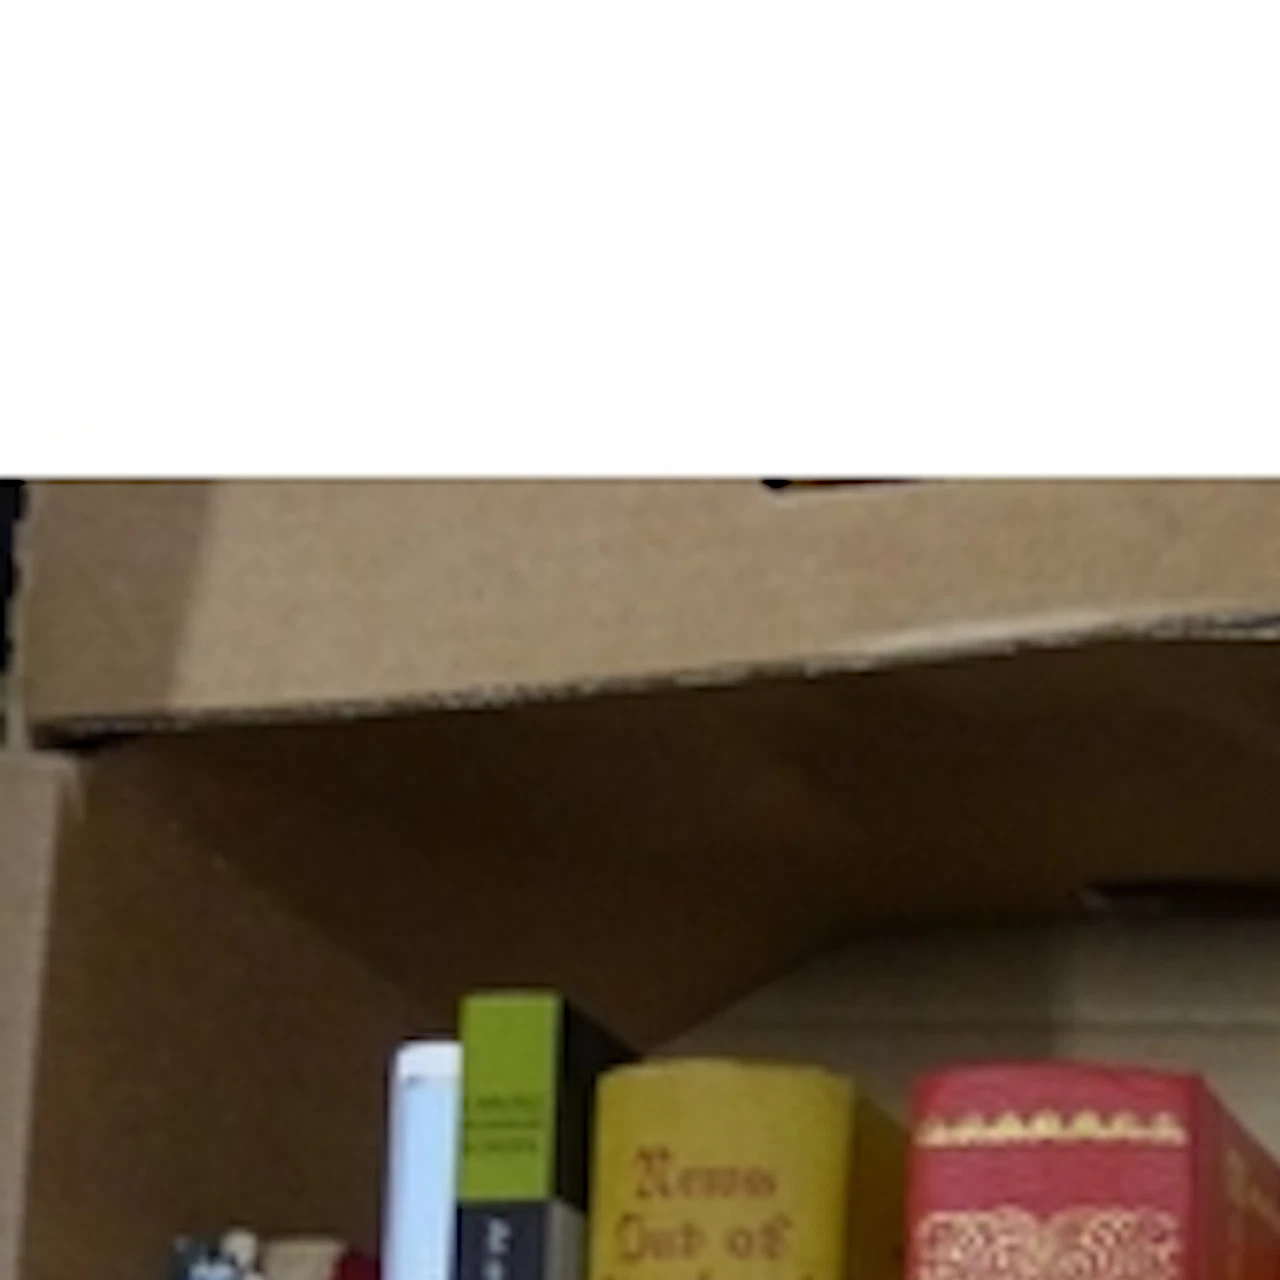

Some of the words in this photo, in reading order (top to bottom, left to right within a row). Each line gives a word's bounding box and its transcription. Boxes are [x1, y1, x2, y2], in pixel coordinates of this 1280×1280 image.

[633, 1146, 780, 1198] News
[612, 1212, 709, 1261] Out
[723, 1214, 793, 1260] of
